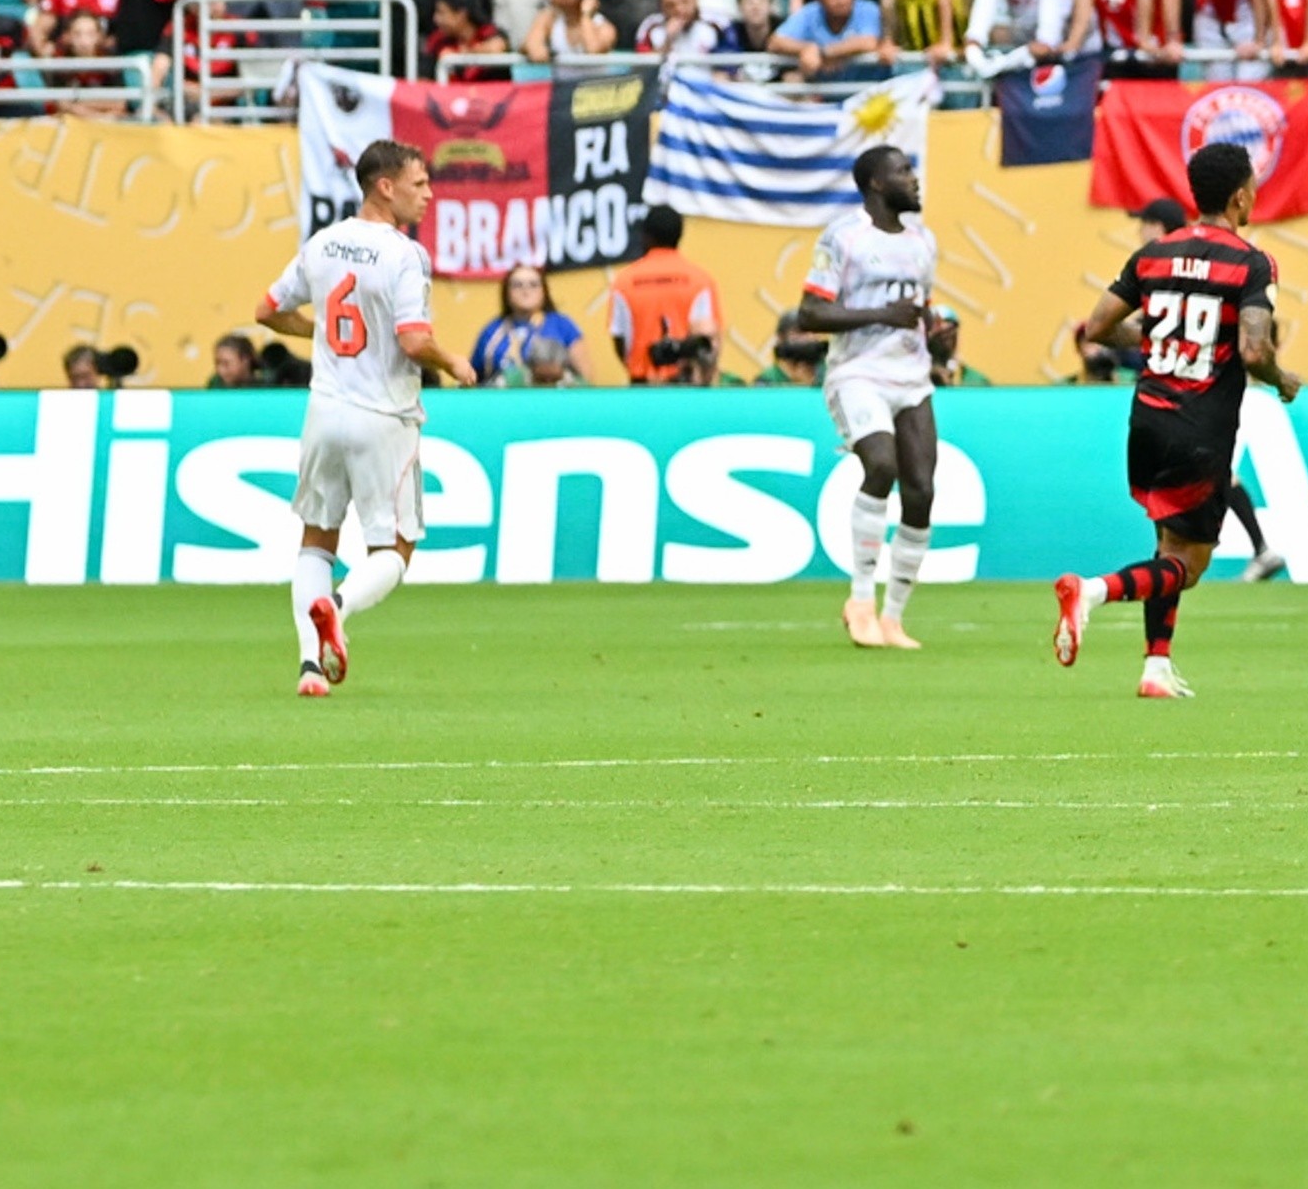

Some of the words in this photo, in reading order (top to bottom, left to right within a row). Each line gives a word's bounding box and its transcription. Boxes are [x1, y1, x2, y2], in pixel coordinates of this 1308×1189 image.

[573, 120, 630, 183] FLA
[322, 241, 381, 266] KIMMICH
[435, 183, 630, 274] BRANCO
[325, 270, 368, 357] 6
[1147, 290, 1222, 380] 29
